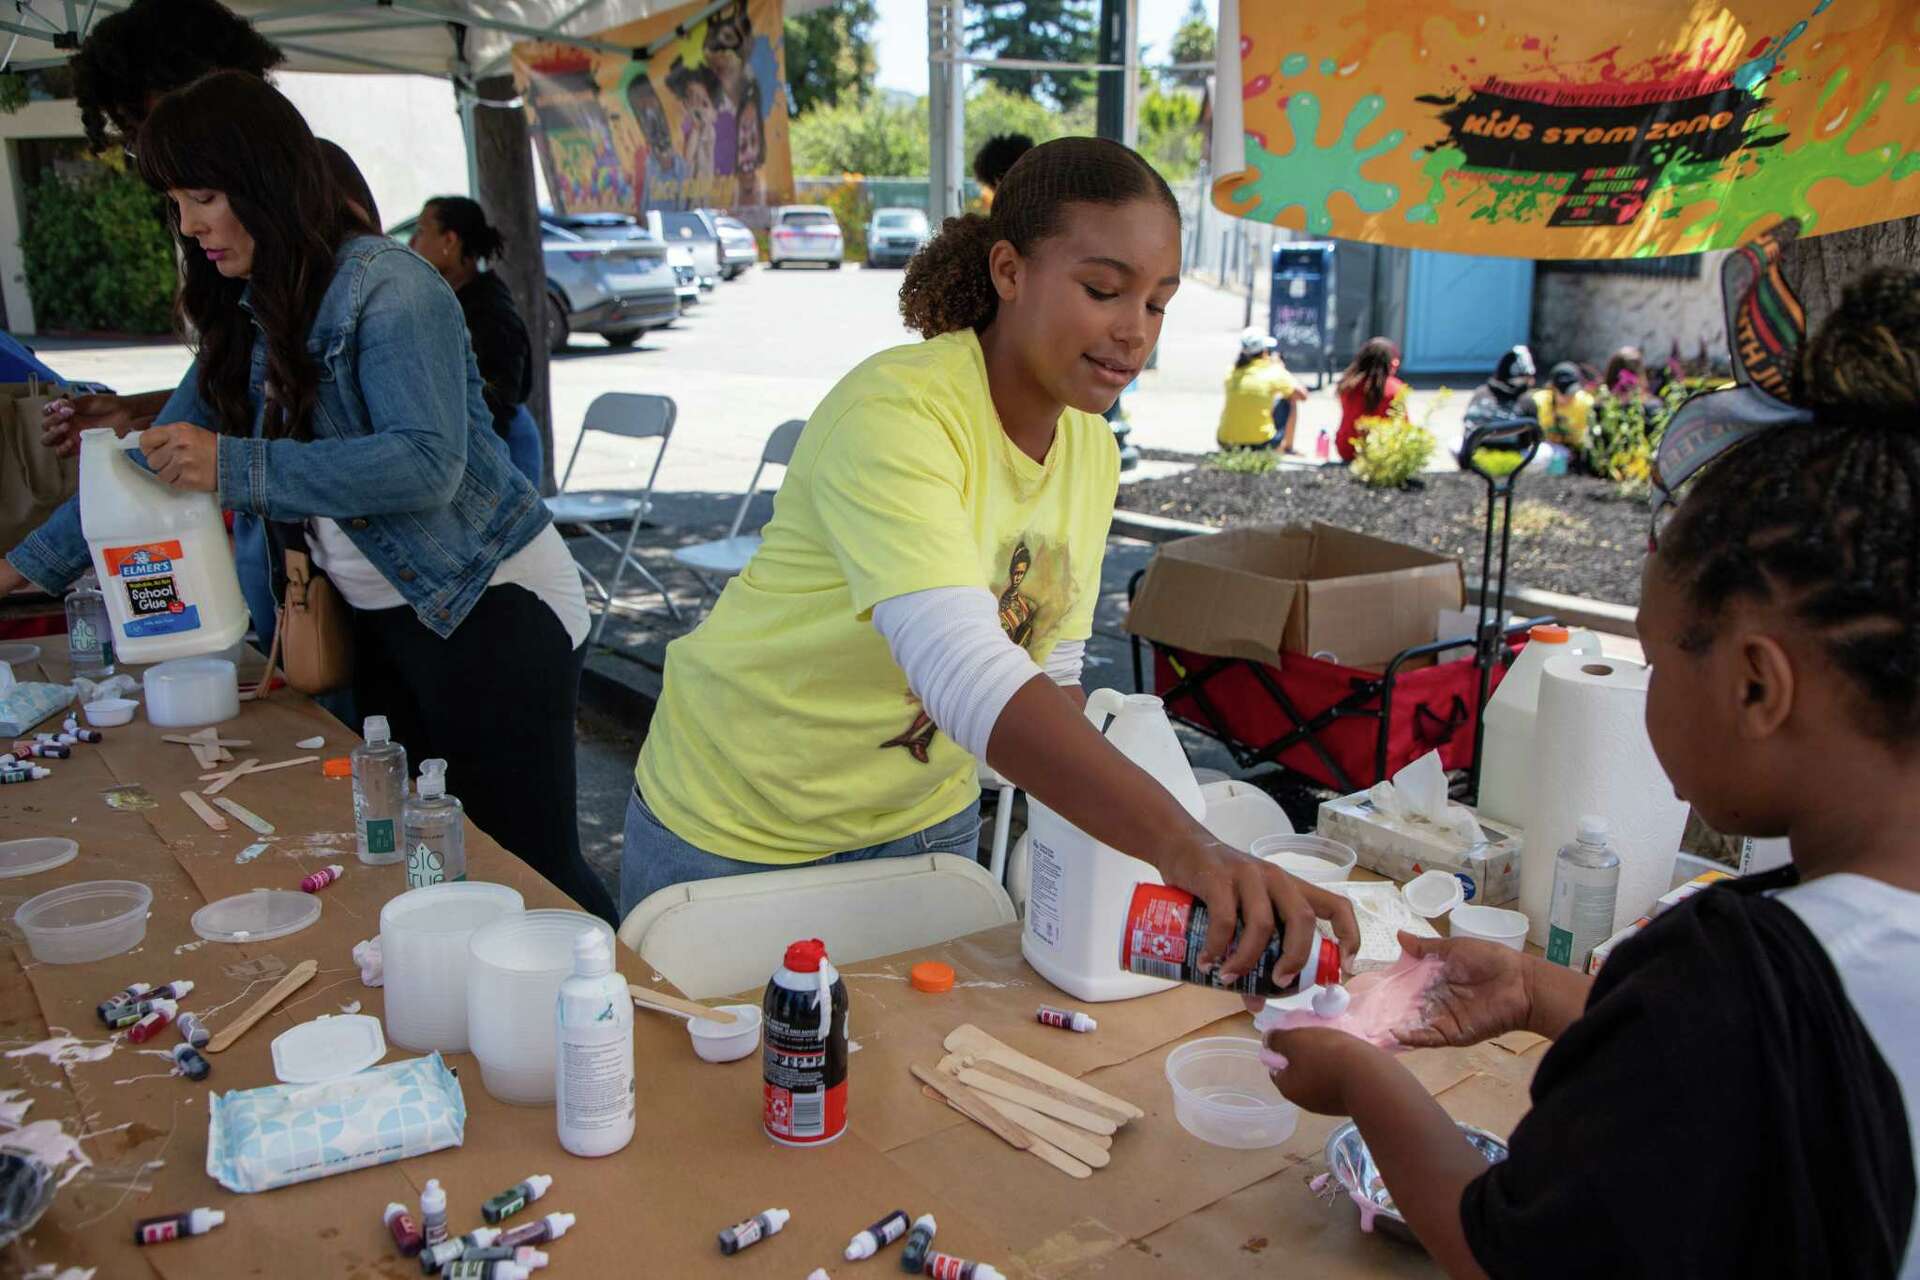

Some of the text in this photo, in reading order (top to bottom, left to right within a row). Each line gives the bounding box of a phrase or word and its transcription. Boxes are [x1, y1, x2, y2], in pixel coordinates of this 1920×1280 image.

[123, 562, 169, 575] ELMER'S
[131, 584, 174, 600] School
[139, 599, 168, 610] Glue
